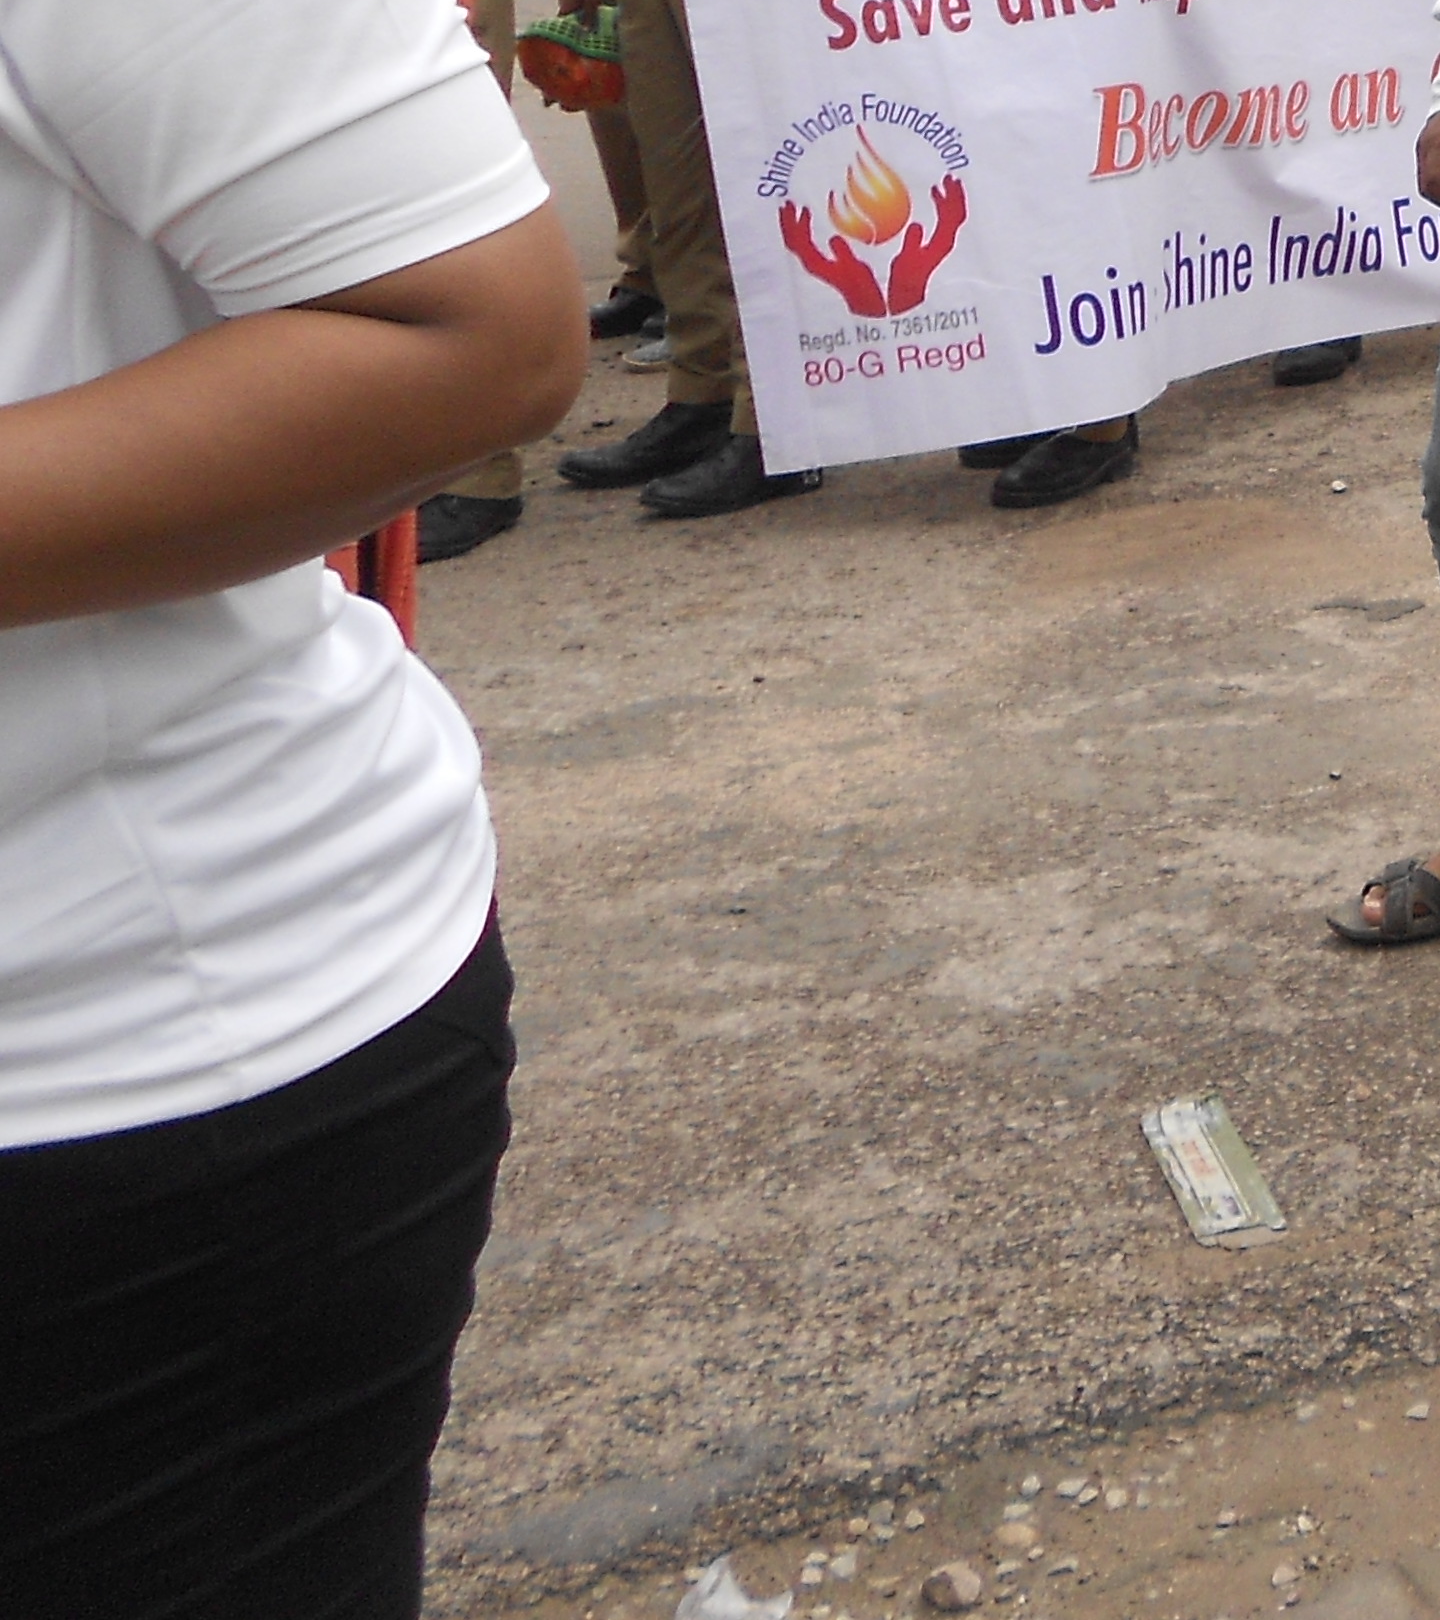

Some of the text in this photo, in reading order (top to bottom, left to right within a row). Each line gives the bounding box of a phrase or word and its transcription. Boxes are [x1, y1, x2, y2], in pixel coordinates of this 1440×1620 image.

[757, 93, 970, 199] Shine India Foundation
[1088, 66, 1405, 179] Become an
[799, 306, 979, 355] Regd. No. 7361/2011
[1034, 265, 1147, 356] Join
[1267, 205, 1384, 286] India
[803, 332, 987, 388] 80-G Regd
